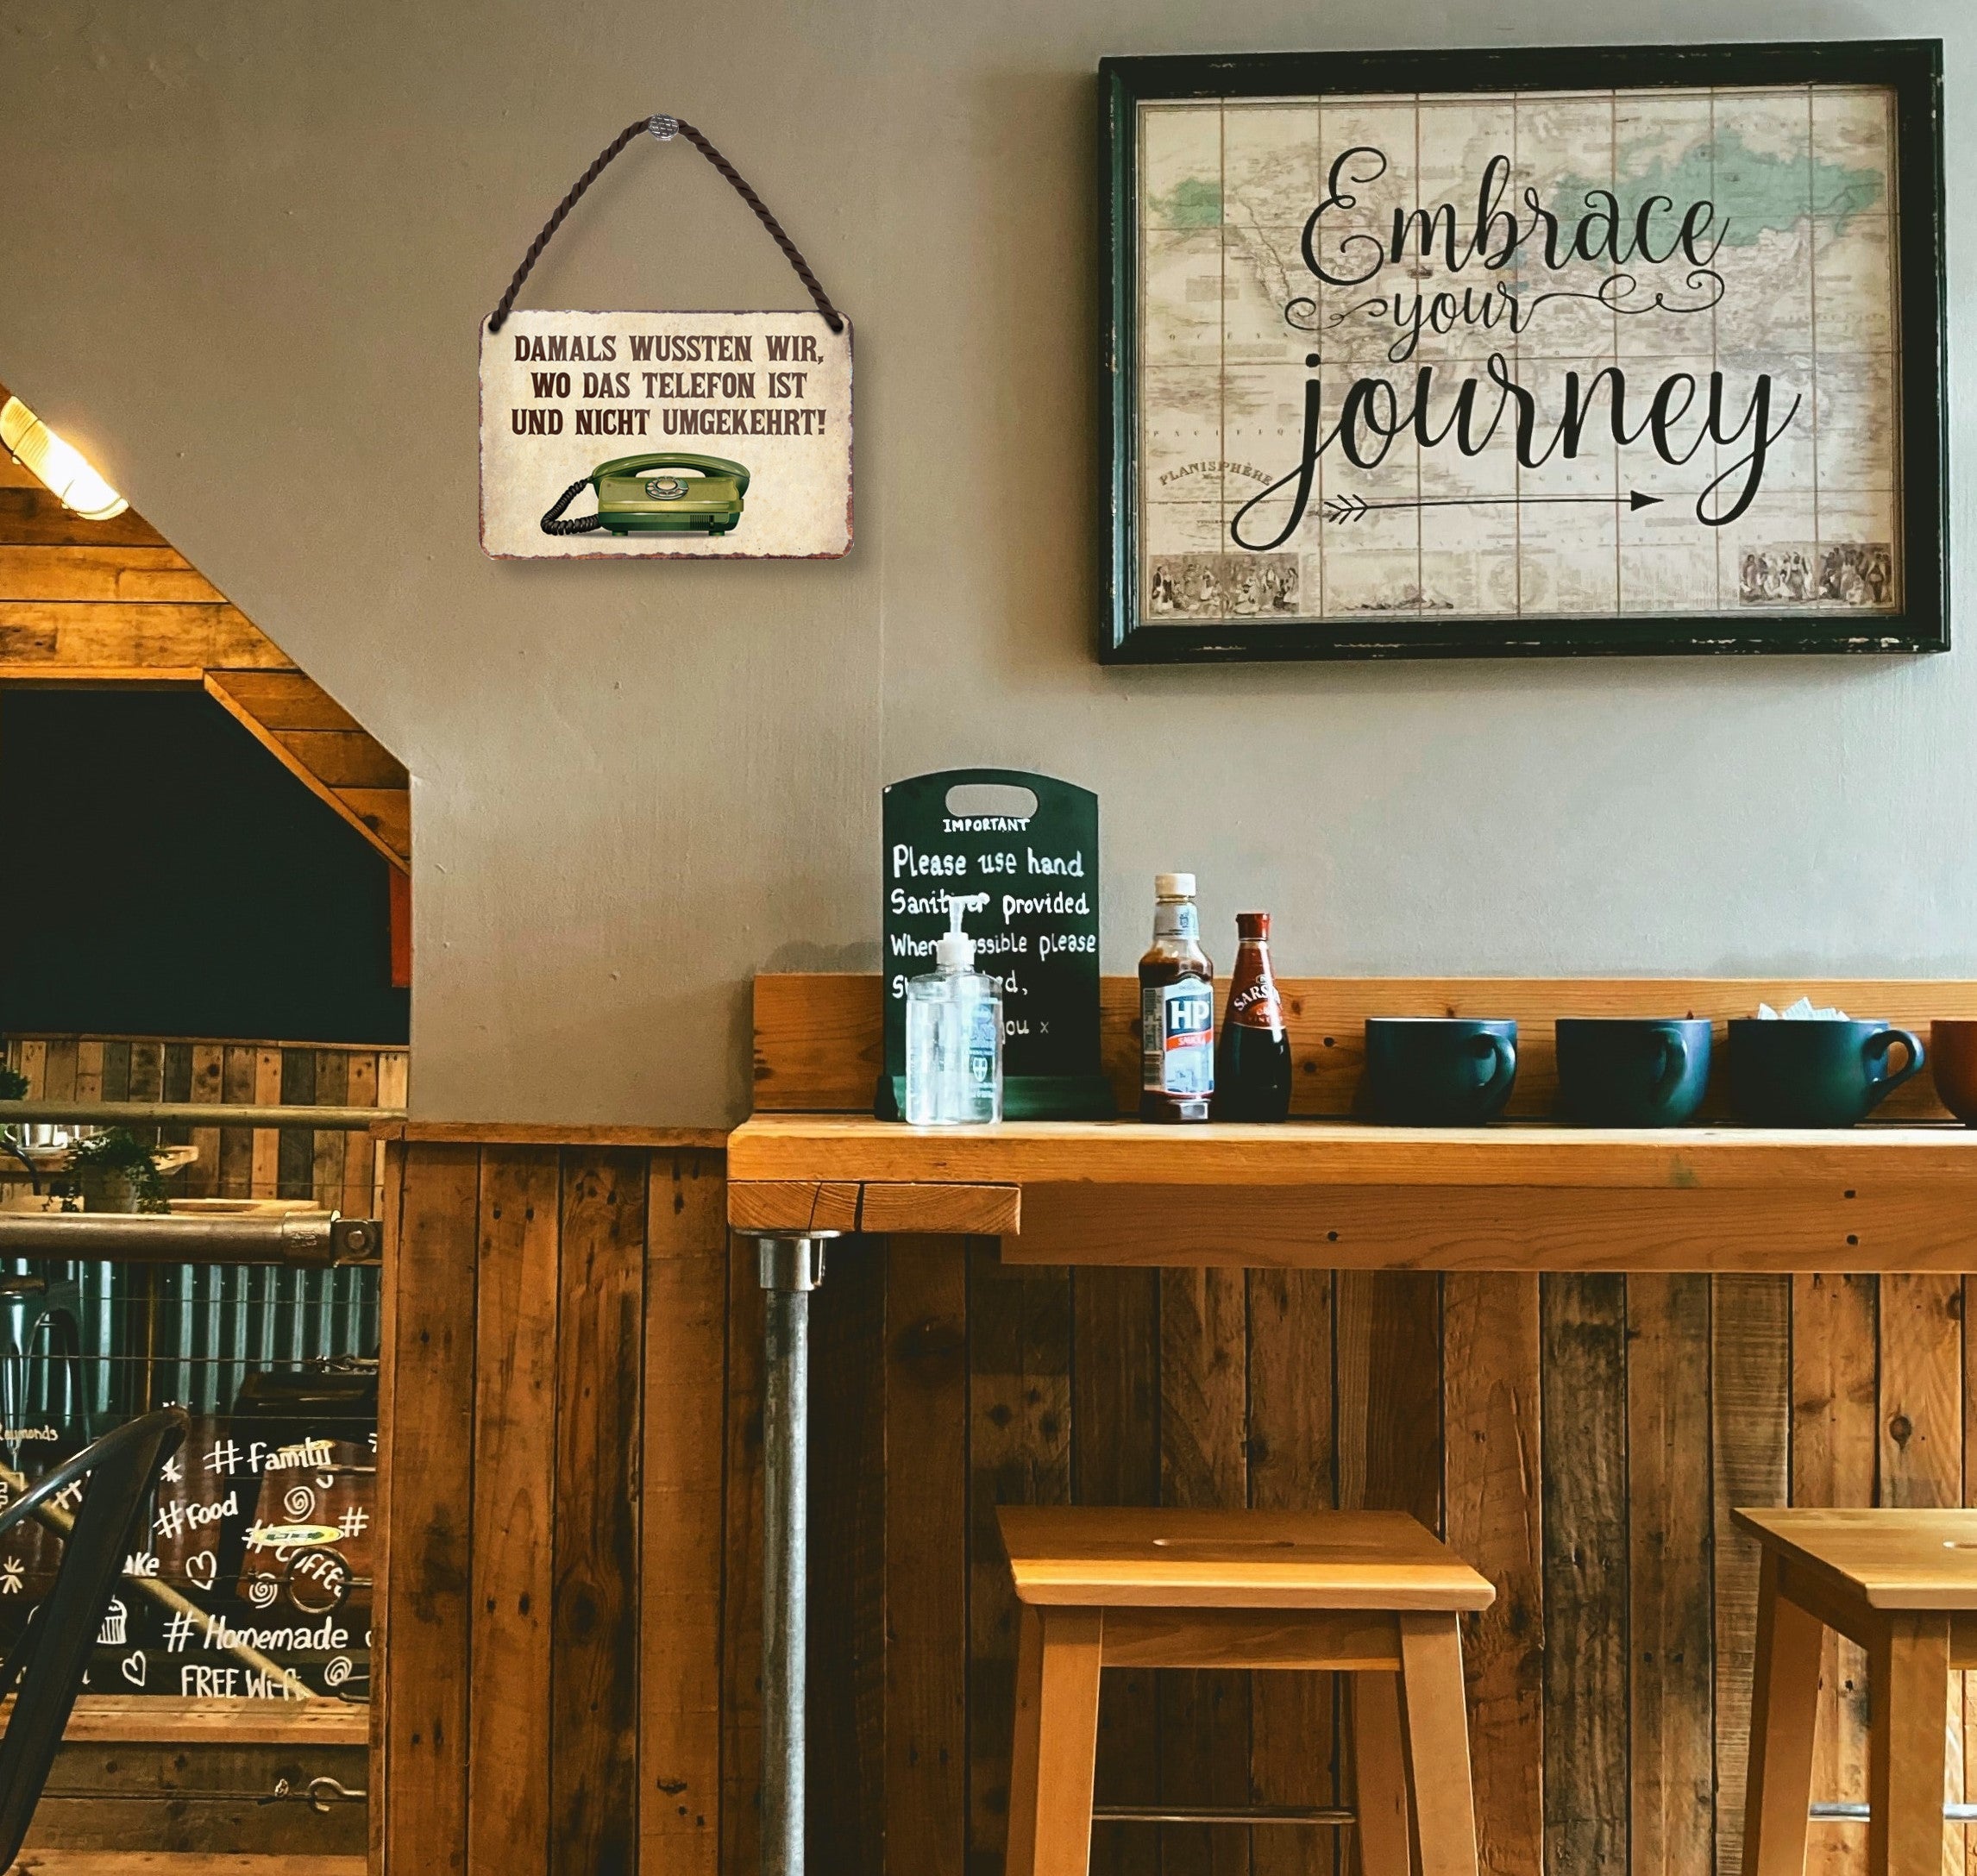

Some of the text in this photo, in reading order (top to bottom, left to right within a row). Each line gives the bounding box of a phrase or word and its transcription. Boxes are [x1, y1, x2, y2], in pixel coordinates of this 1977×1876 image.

[1301, 147, 1730, 286] Embrace
[1387, 279, 1535, 364] your
[514, 335, 825, 365] DAMALS WUSSTEN WIR,
[531, 372, 808, 398] WO DAS TELEFON IST
[511, 409, 827, 436] UND NICHT UMGEKEHRT!
[1230, 352, 1803, 552] journey
[1159, 461, 1274, 486] PLANISPHÈRE
[943, 818, 1031, 833] IMPORTANT
[893, 844, 1085, 878] Please use hand
[1002, 891, 1090, 925] provided
[1039, 932, 1096, 962] please
[1171, 1000, 1209, 1030] HP
[181, 1665, 240, 1698] FREE
